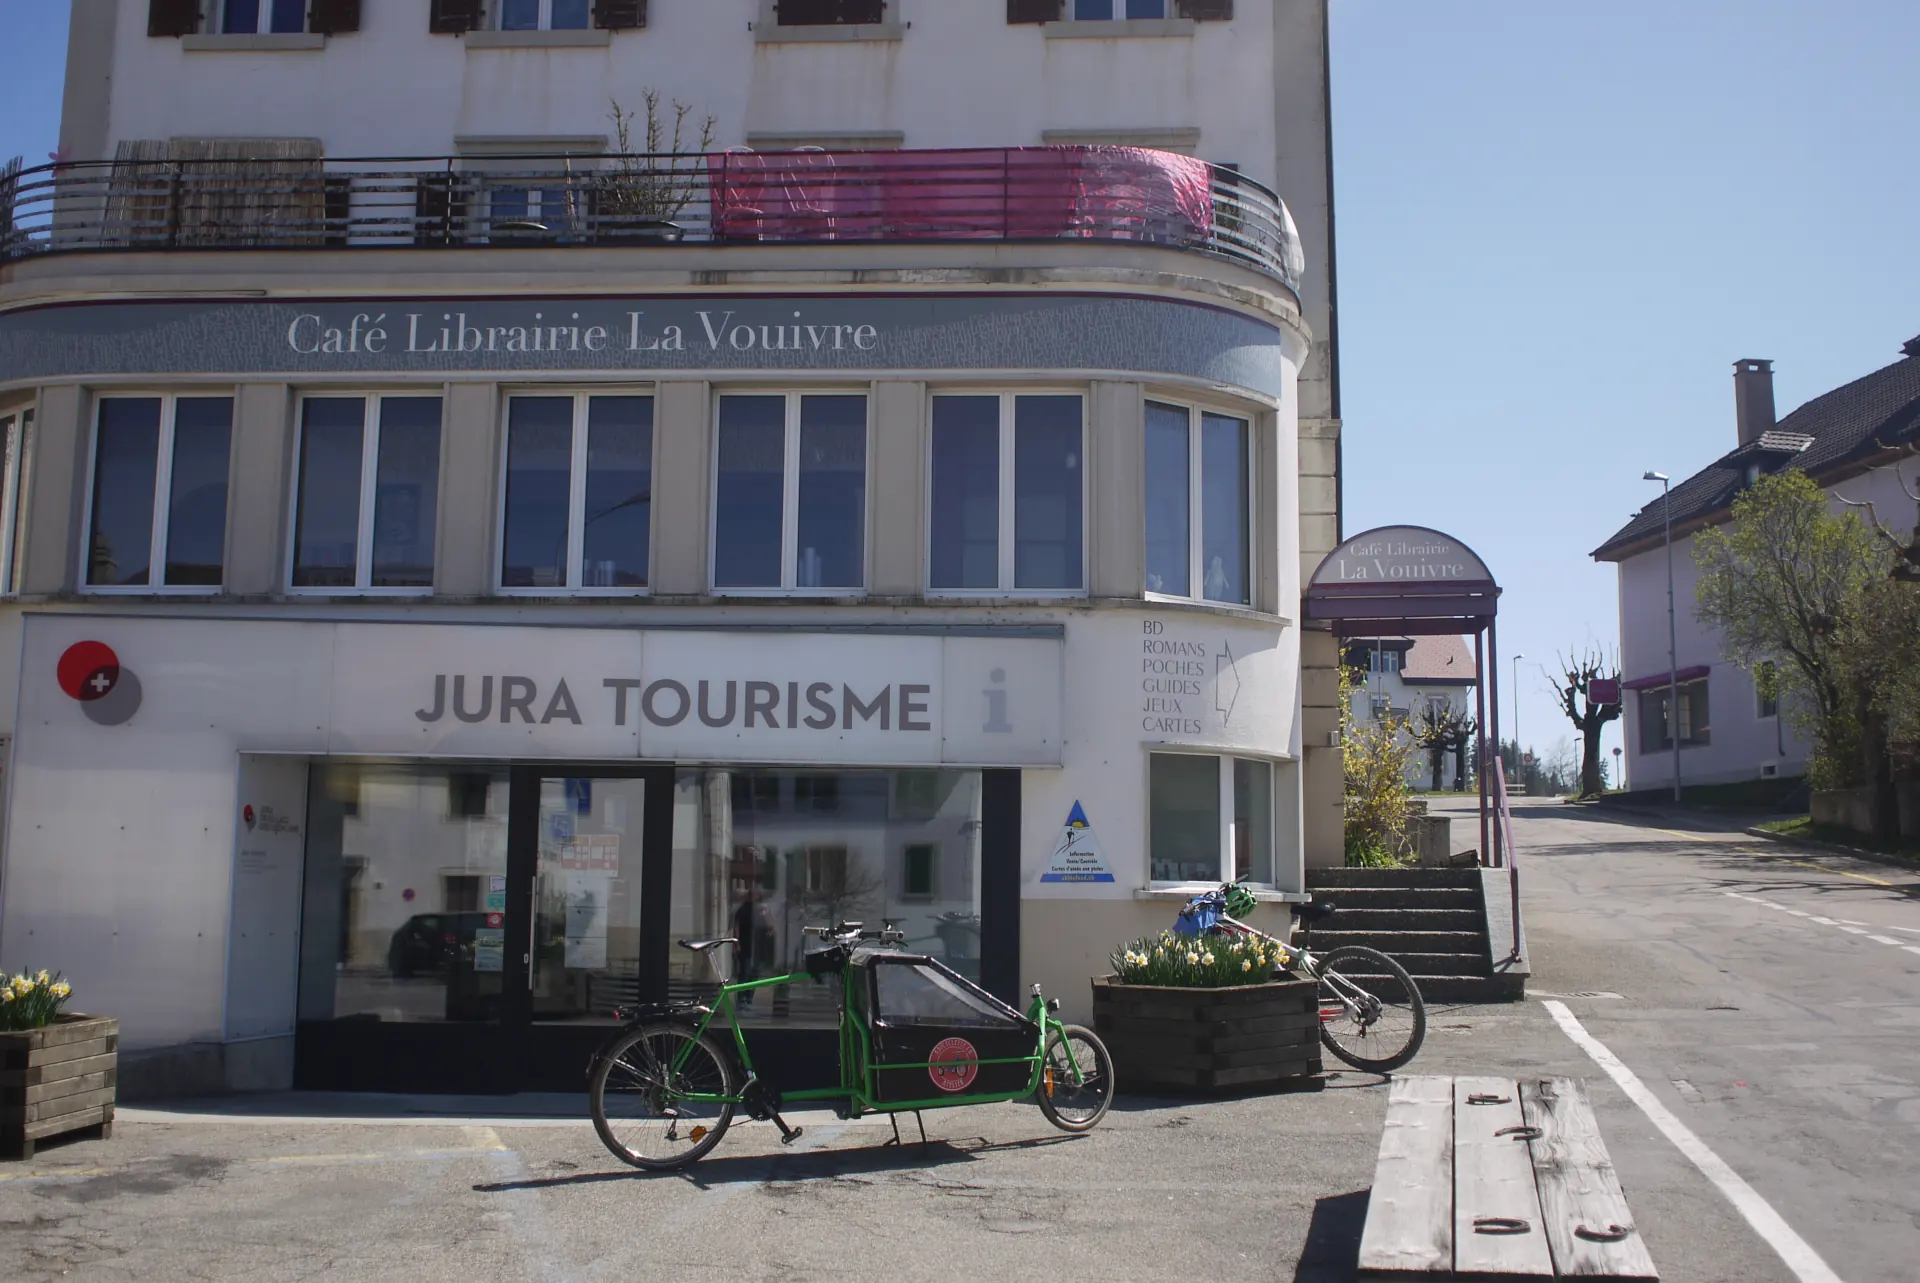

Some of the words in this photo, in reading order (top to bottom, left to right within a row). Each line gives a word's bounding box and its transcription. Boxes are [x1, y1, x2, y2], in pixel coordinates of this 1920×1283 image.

[288, 313, 387, 353] Café
[404, 312, 607, 352] Librairie
[626, 312, 685, 351] La
[695, 311, 877, 351] Vouivre
[1350, 541, 1383, 556] Café
[1387, 540, 1450, 556] Librairie
[1339, 559, 1368, 580] La
[1374, 557, 1465, 579] Vouivre
[1143, 620, 1164, 635] BD
[1143, 639, 1206, 657] ROMANS
[1143, 658, 1205, 677] POCHES
[1142, 678, 1201, 695] GUIDES
[414, 674, 583, 725] JURA
[602, 678, 931, 731] TOURISME
[1142, 698, 1183, 714] JEUX
[1142, 717, 1202, 734] CARTES
